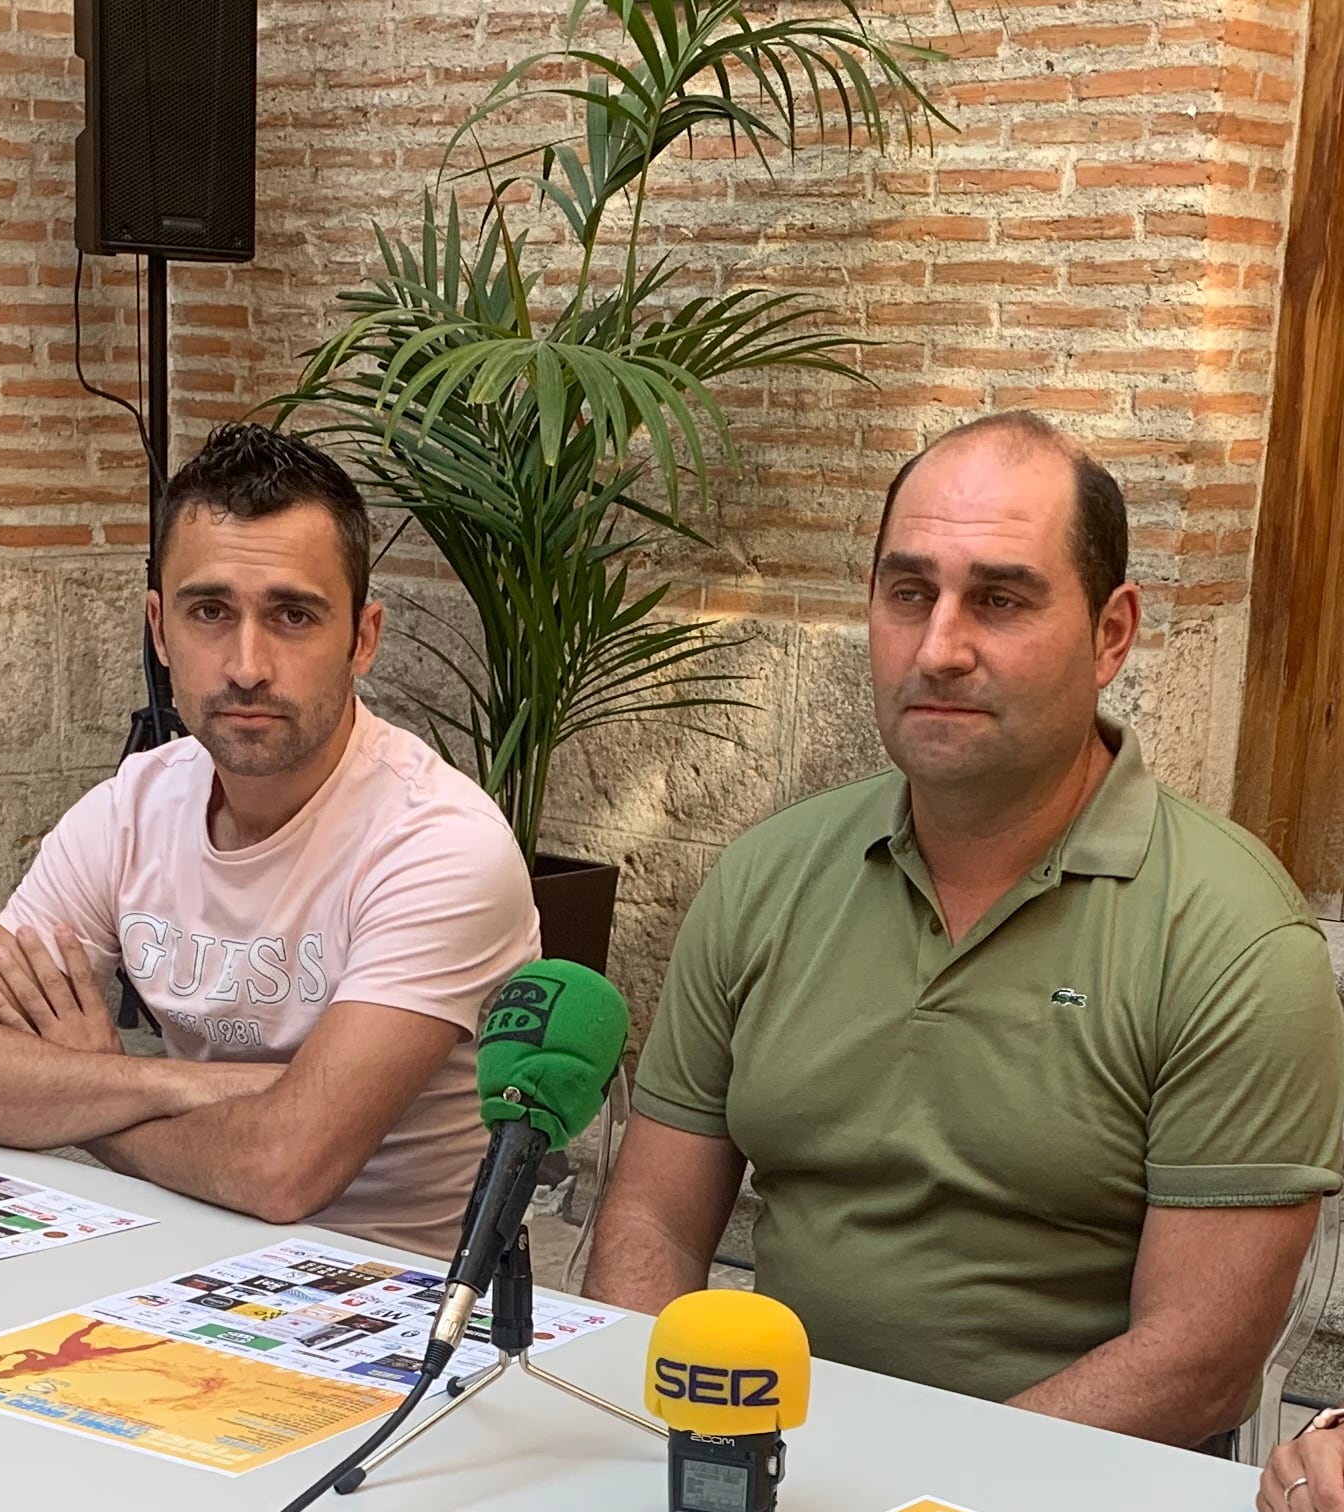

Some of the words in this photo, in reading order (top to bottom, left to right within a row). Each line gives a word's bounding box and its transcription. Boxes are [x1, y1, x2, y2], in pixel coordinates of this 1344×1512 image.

[120, 913, 327, 1004] GUESS
[205, 1018, 262, 1045] 1981
[481, 1012, 529, 1036] ERO
[655, 1358, 780, 1406] SER
